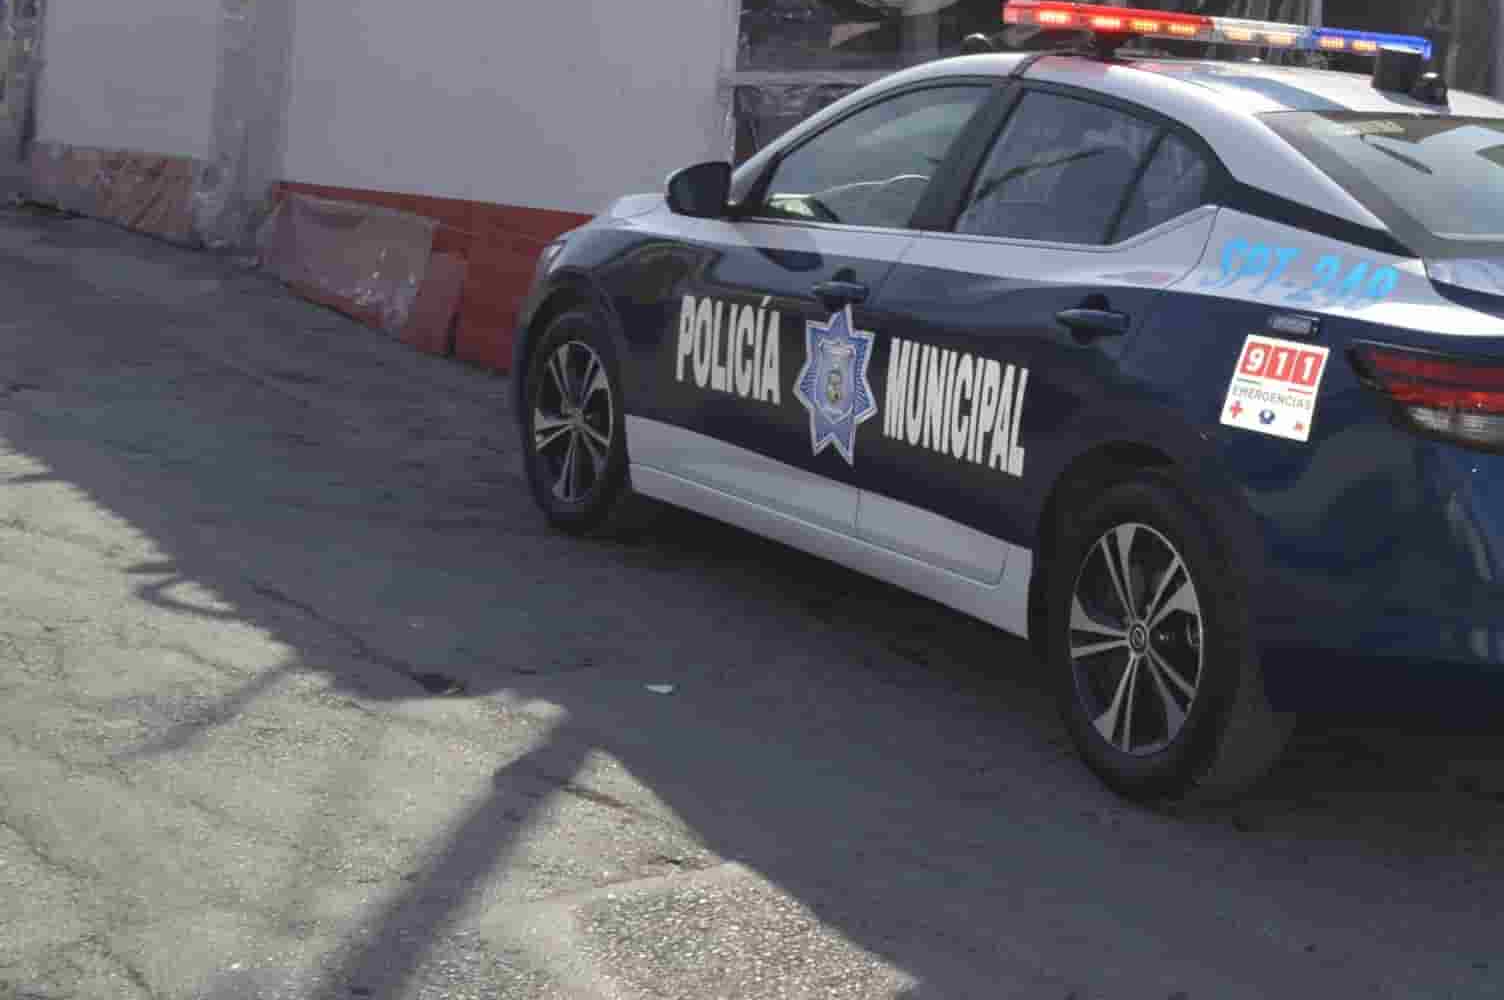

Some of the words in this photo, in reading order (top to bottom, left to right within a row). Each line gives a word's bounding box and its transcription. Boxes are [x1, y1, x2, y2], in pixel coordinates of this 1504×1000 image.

[675, 294, 781, 405] POLICÍA
[1245, 345, 1316, 383] 911
[882, 336, 1030, 478] MUNICIPAL
[1231, 384, 1312, 410] EMERGENCIAS
